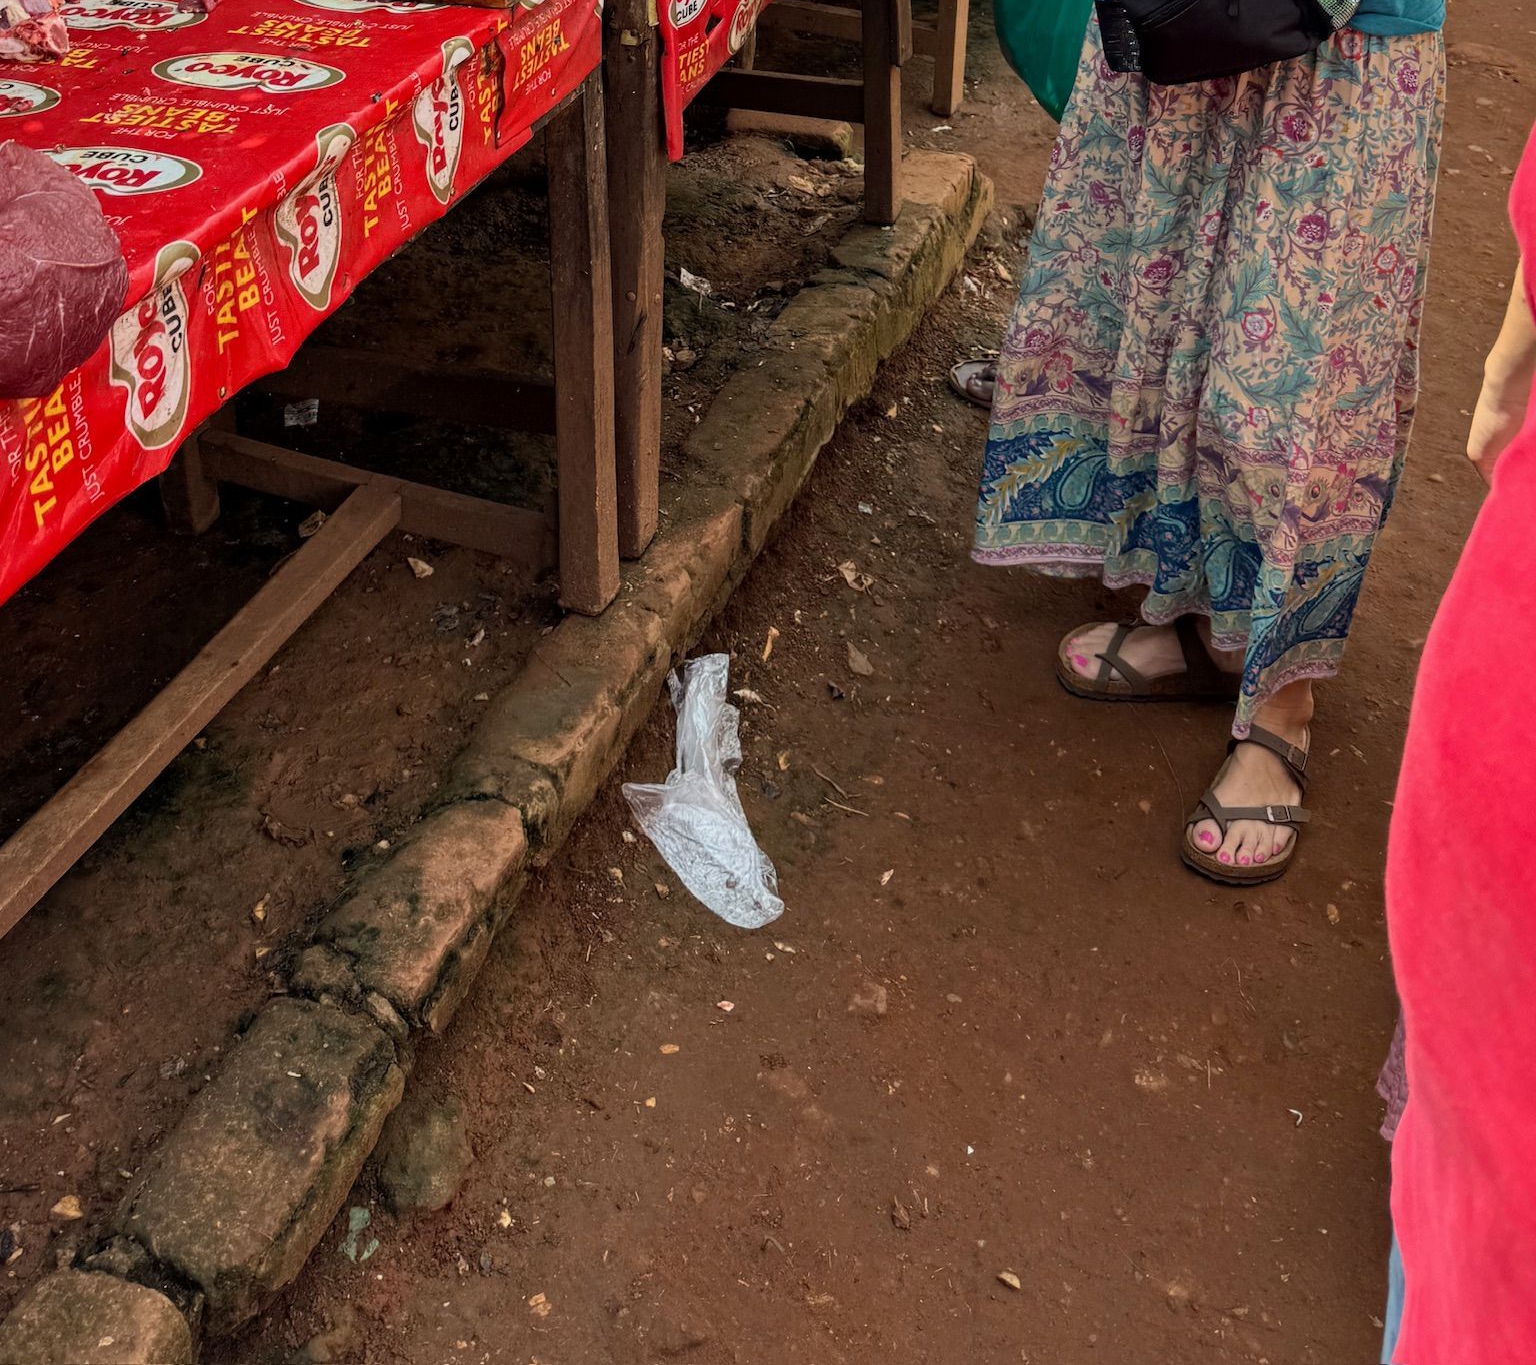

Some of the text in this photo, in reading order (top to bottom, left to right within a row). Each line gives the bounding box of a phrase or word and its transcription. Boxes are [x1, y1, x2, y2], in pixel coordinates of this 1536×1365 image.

[60, 6, 177, 26] Royco
[676, 0, 697, 22] CUBE
[227, 25, 371, 48] TASTIEST
[260, 19, 366, 36] BEANS
[258, 38, 288, 47] THE
[520, 18, 561, 66] BEANS
[234, 55, 297, 68] CUBE
[184, 62, 310, 87] Royco
[538, 67, 552, 85] FOR
[109, 92, 178, 105] CRUMBLE
[80, 111, 241, 135] TASTIEST
[122, 103, 230, 123] BEANS
[111, 127, 179, 139] FOR THE
[80, 150, 149, 165] CUBE
[355, 170, 365, 200] FOR
[396, 199, 413, 232] JUST
[203, 277, 216, 316] FOR
[266, 310, 286, 346] JUST
[82, 464, 106, 504] JUST
